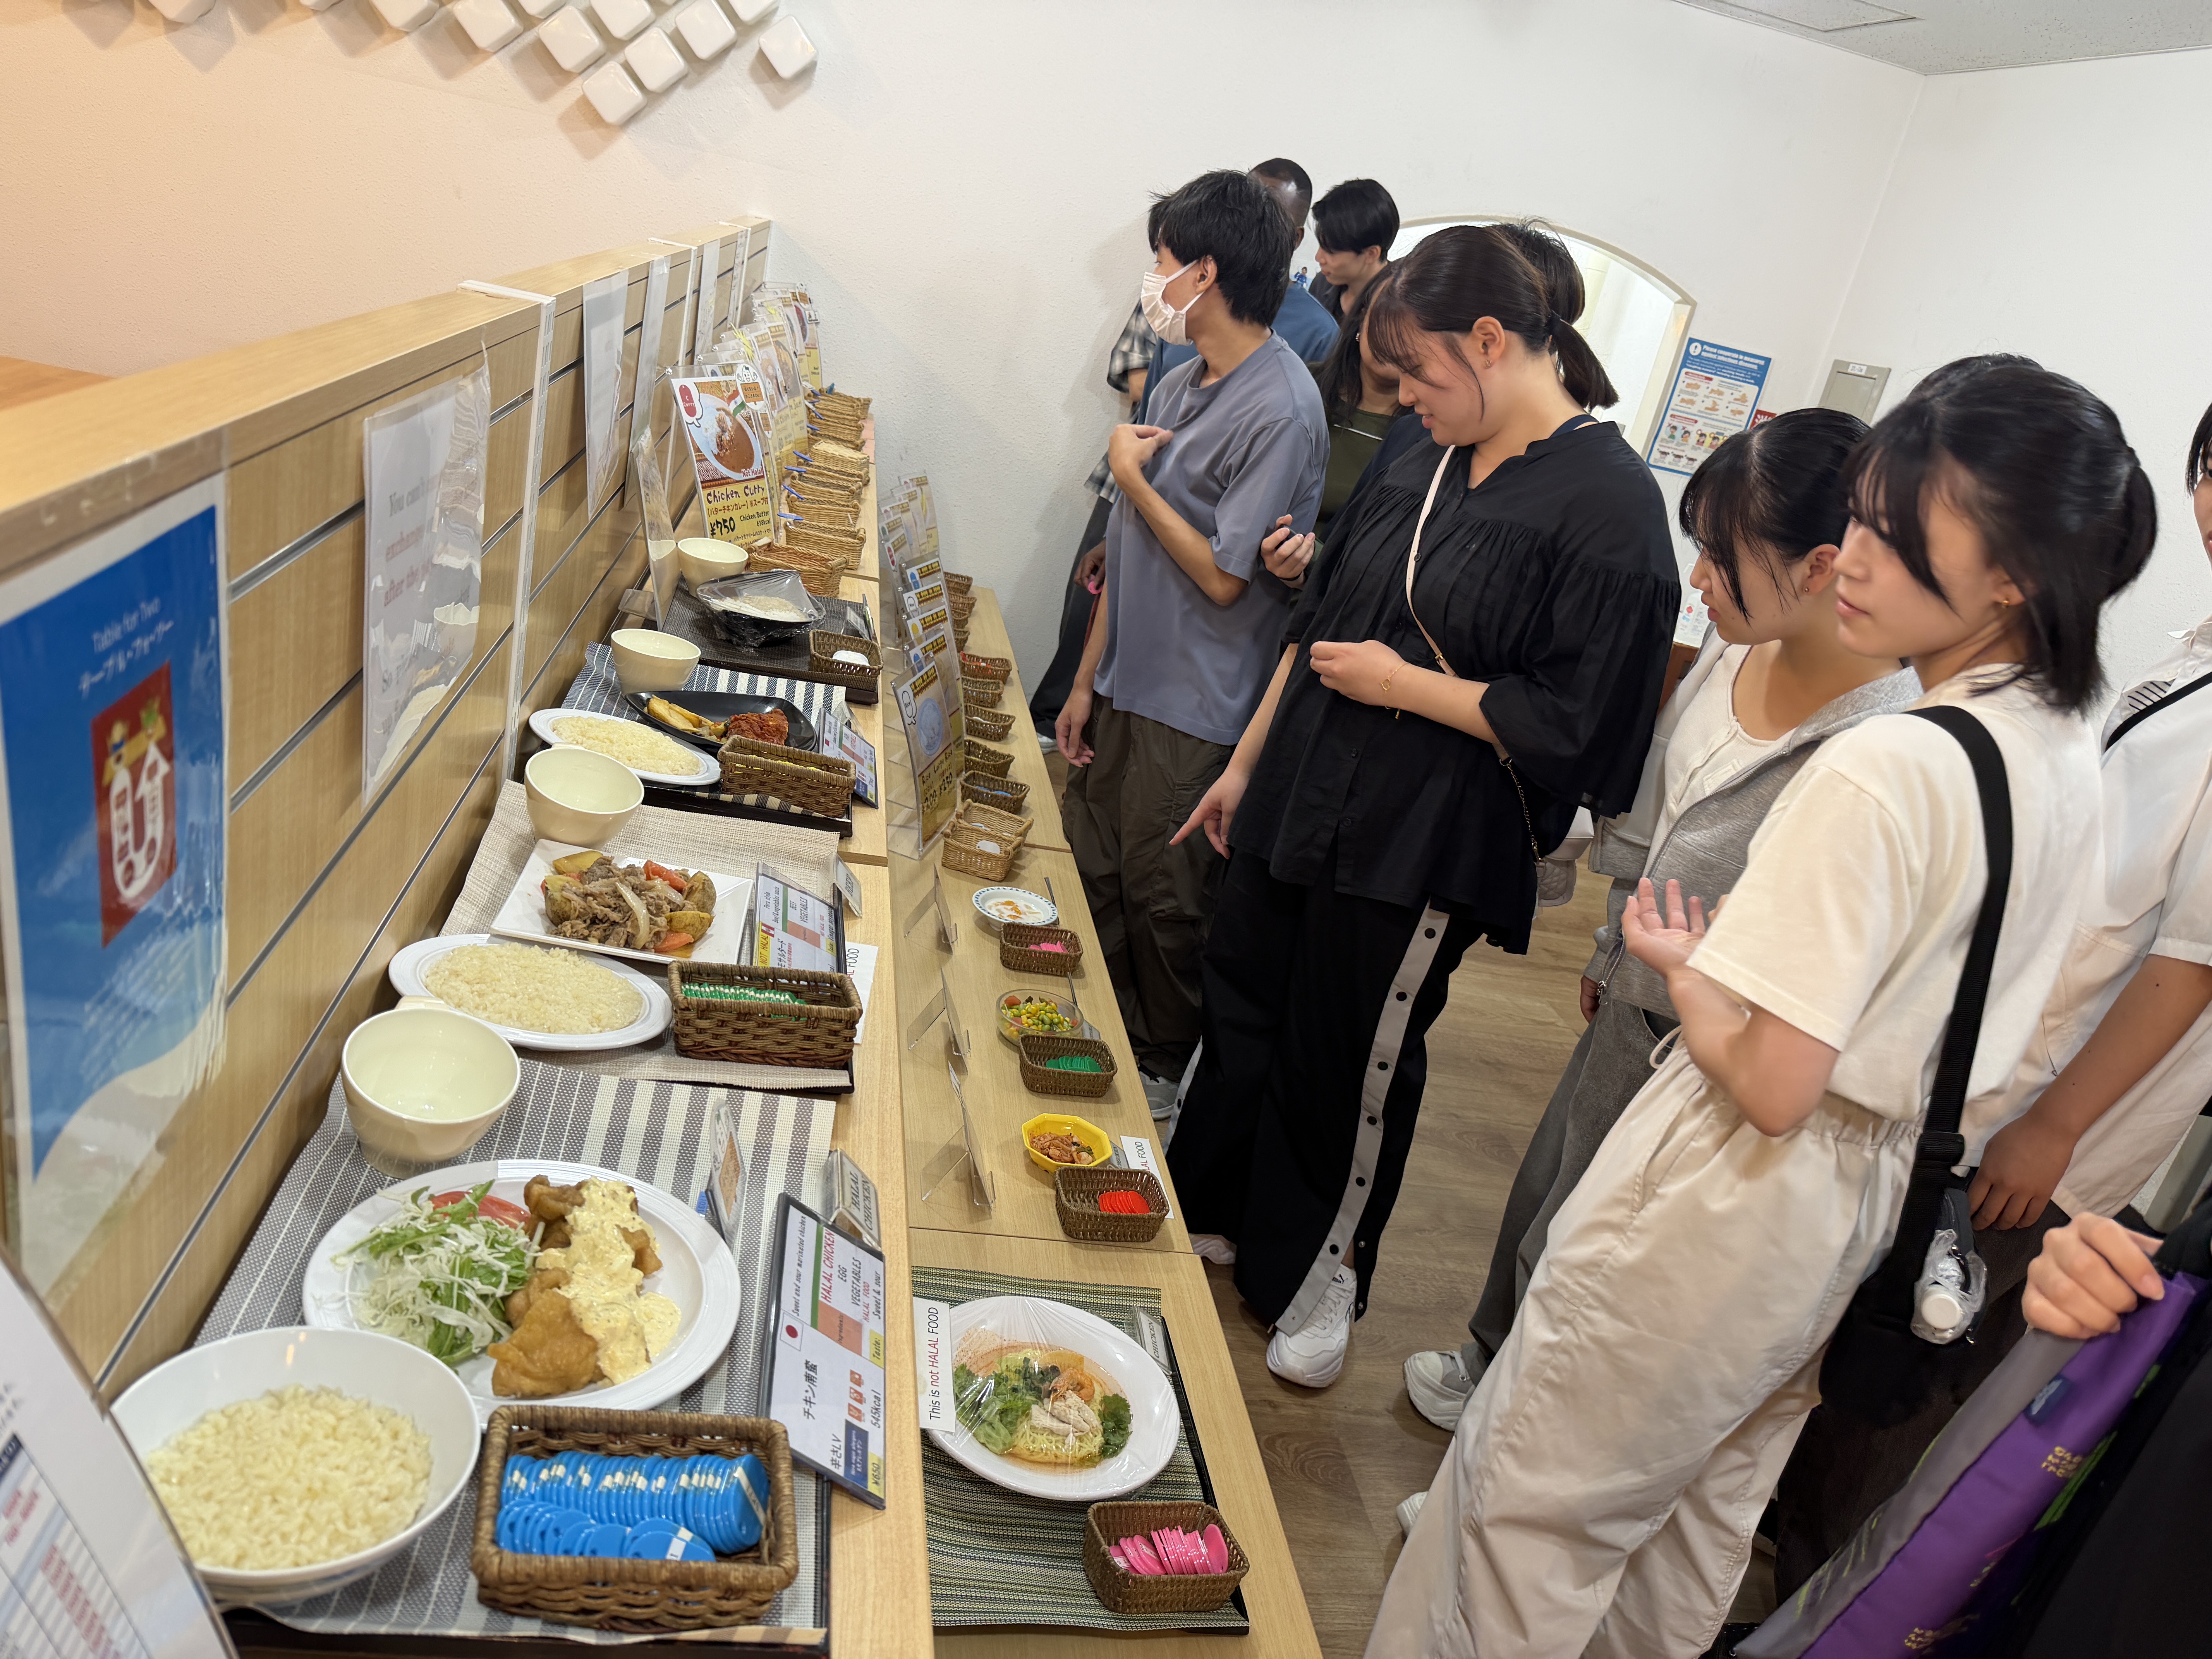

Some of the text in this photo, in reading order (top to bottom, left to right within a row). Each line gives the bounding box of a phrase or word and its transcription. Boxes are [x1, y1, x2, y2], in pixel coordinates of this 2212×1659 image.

[742, 467, 763, 477] Not Halal
[389, 493, 404, 517] You
[707, 484, 764, 504] Chicken Curry
[710, 517, 735, 538] ¥750
[740, 511, 769, 521] Chicken/Butter
[123, 611, 139, 633] for
[800, 896, 808, 923] VEGETABLES
[761, 935, 769, 951] HALAL
[1135, 1141, 1146, 1158] FOOD
[851, 1172, 861, 1211] HALAL
[862, 1177, 873, 1231] CHICKEN
[797, 1236, 805, 1268] marinated
[821, 1230, 835, 1303] HALAL CHICKEN
[838, 1265, 847, 1282] EGG
[851, 1257, 862, 1306] VEGETABLES
[872, 1297, 881, 1319] Sweet
[872, 1338, 881, 1360] Taste:
[1147, 1319, 1159, 1358] CHICKEN
[928, 1307, 941, 1420] This is not HALAL FOOD
[871, 1389, 881, 1428] 545kcal
[871, 1462, 880, 1486] ¥650
